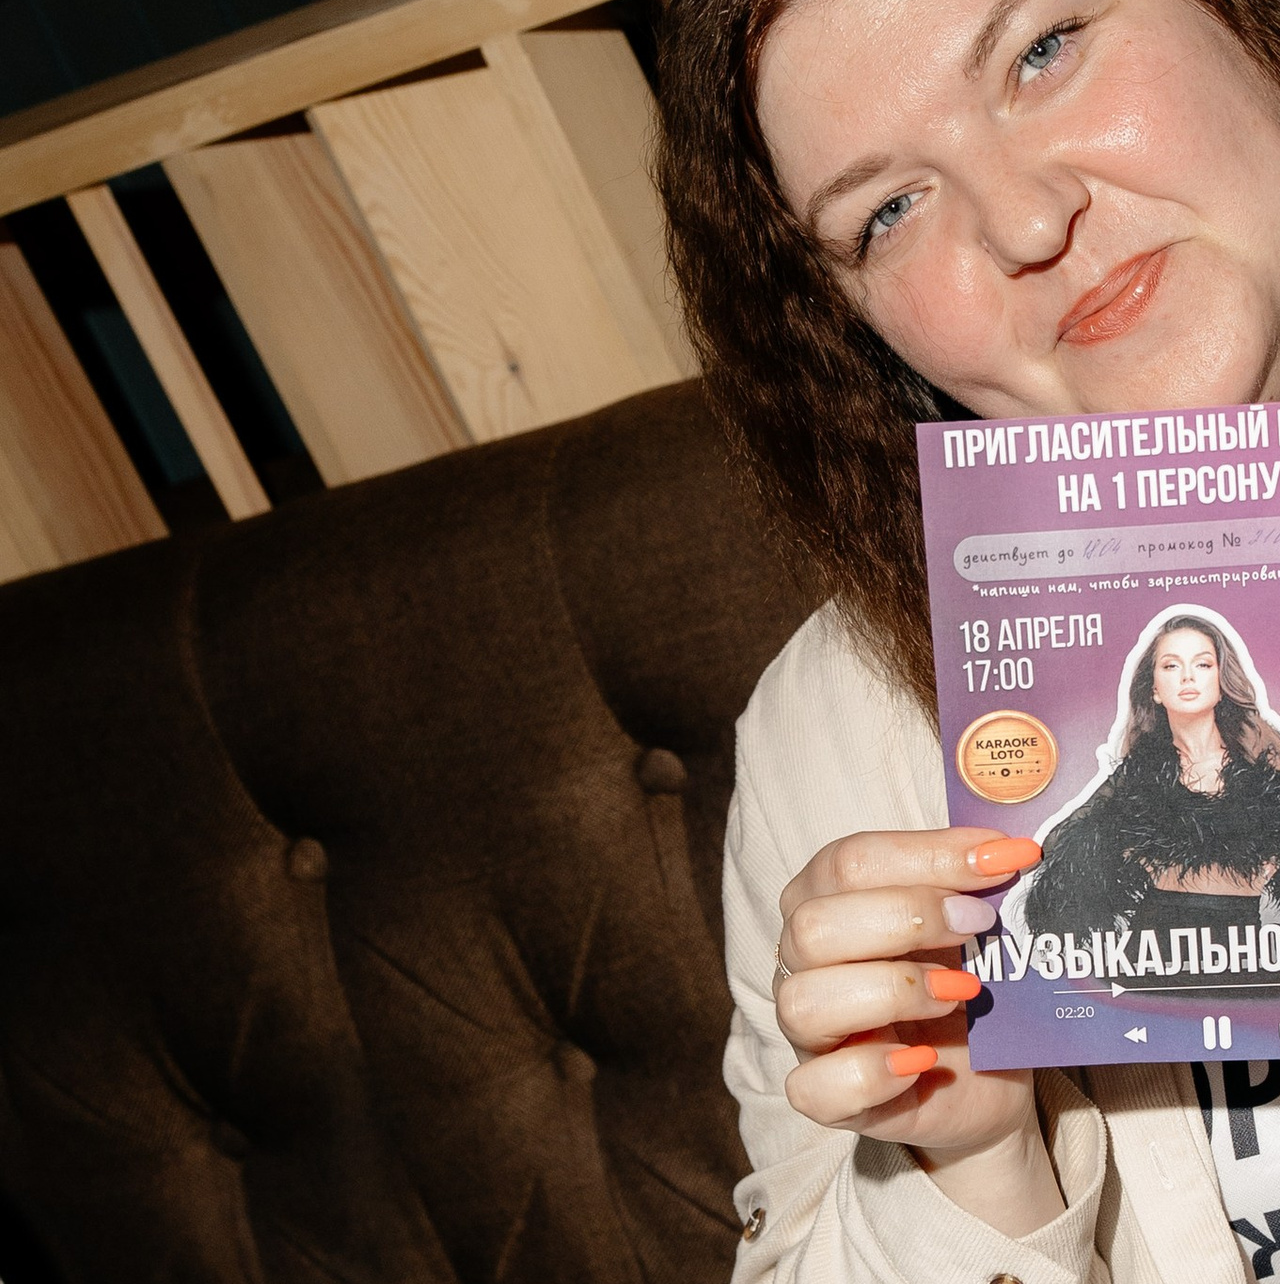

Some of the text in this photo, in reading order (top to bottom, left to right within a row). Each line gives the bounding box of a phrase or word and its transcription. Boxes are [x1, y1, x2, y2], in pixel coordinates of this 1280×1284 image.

[943, 404, 1269, 468] ПРИГЛАСИТЕЛЬНЫЙ
[1057, 473, 1101, 514] НА
[1112, 471, 1126, 510] 1
[1058, 549, 1074, 564] до
[1138, 539, 1214, 558] промокод
[1048, 582, 1082, 594] нам,
[1089, 574, 1139, 590] чтобы
[959, 613, 1104, 653] 18 АПРЕЛЯ
[962, 657, 1034, 693] 17:00
[976, 737, 1038, 750] KARAOKE
[990, 749, 1025, 760] LOTO
[1055, 1005, 1095, 1019] 02:20
